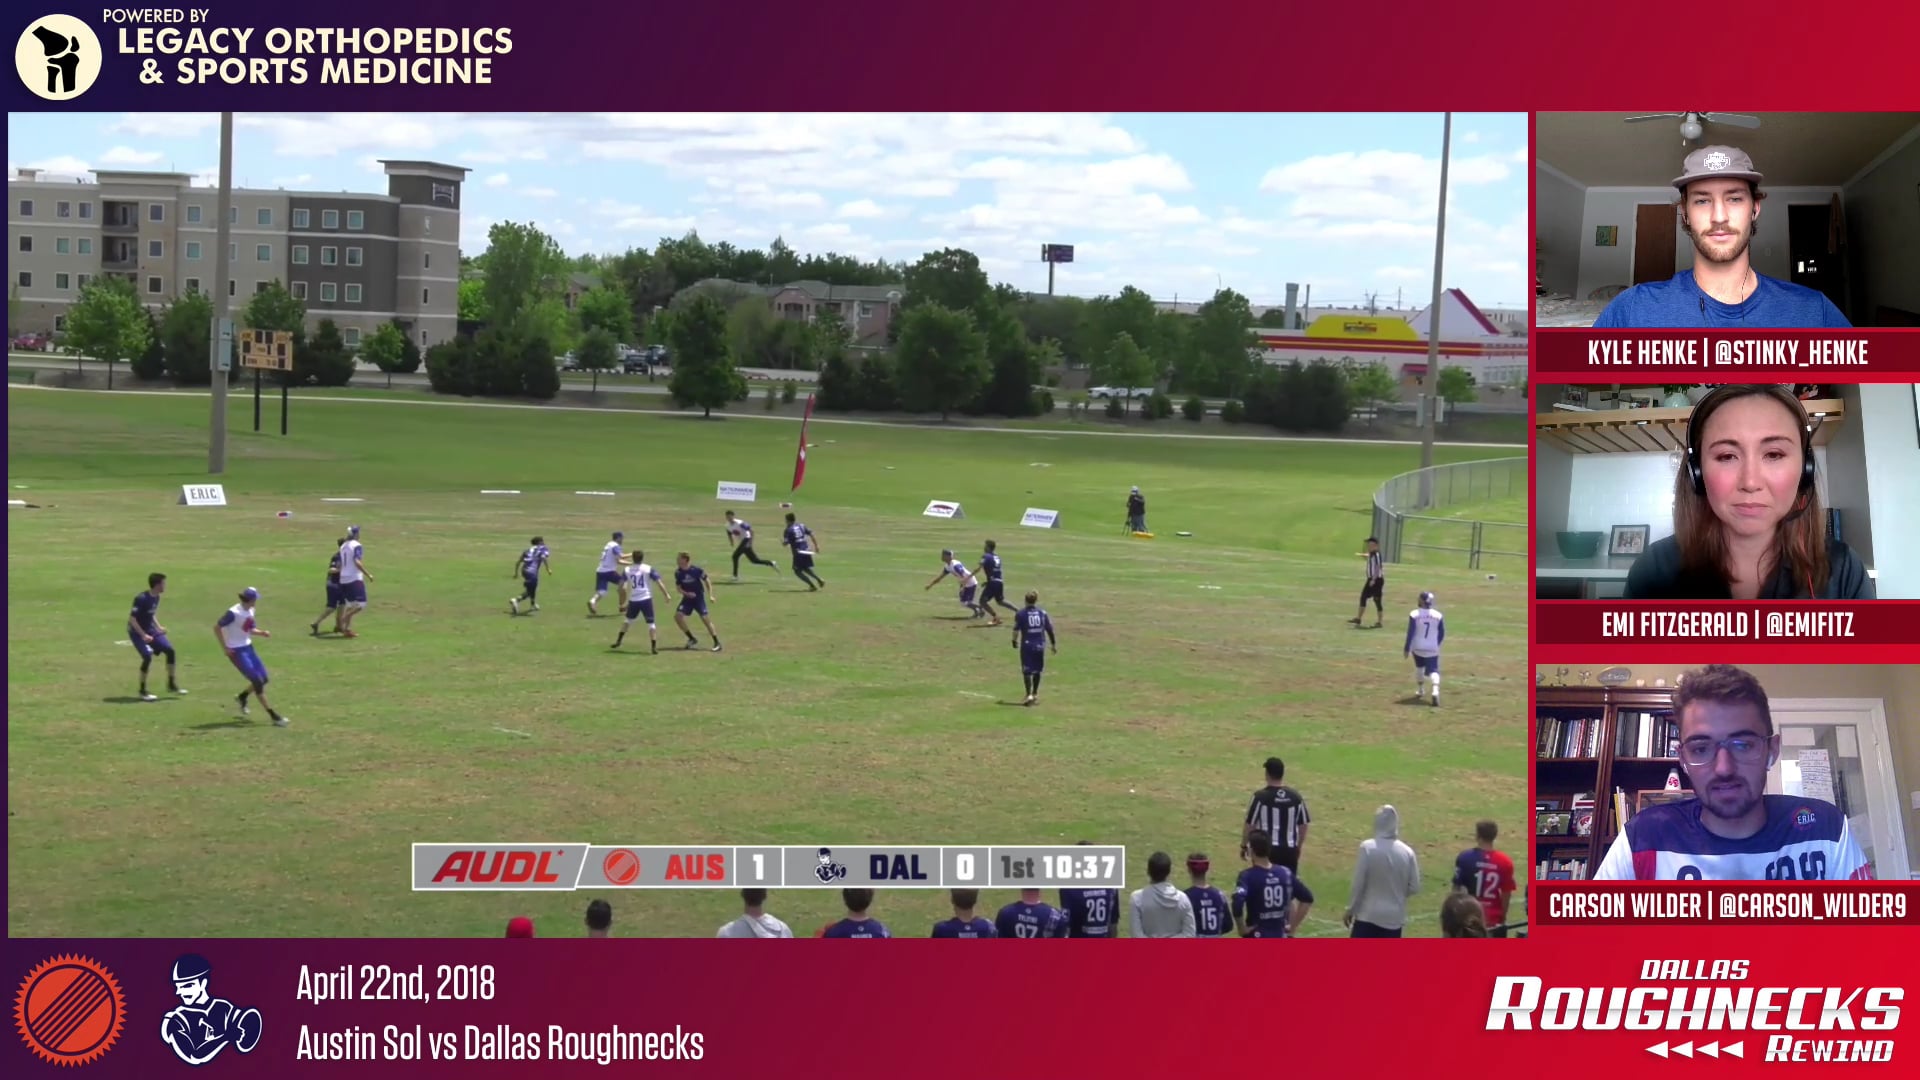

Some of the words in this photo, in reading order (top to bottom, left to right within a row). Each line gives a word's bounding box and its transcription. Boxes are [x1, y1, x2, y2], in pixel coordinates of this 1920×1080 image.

[630, 574, 645, 589] 34
[1028, 615, 1041, 627] 00
[1423, 621, 1430, 639] 7
[1474, 869, 1500, 899] 12
[1263, 885, 1284, 908] 99
[1086, 898, 1106, 922] 26
[1200, 907, 1217, 930] 15
[1015, 922, 1038, 938] 97
